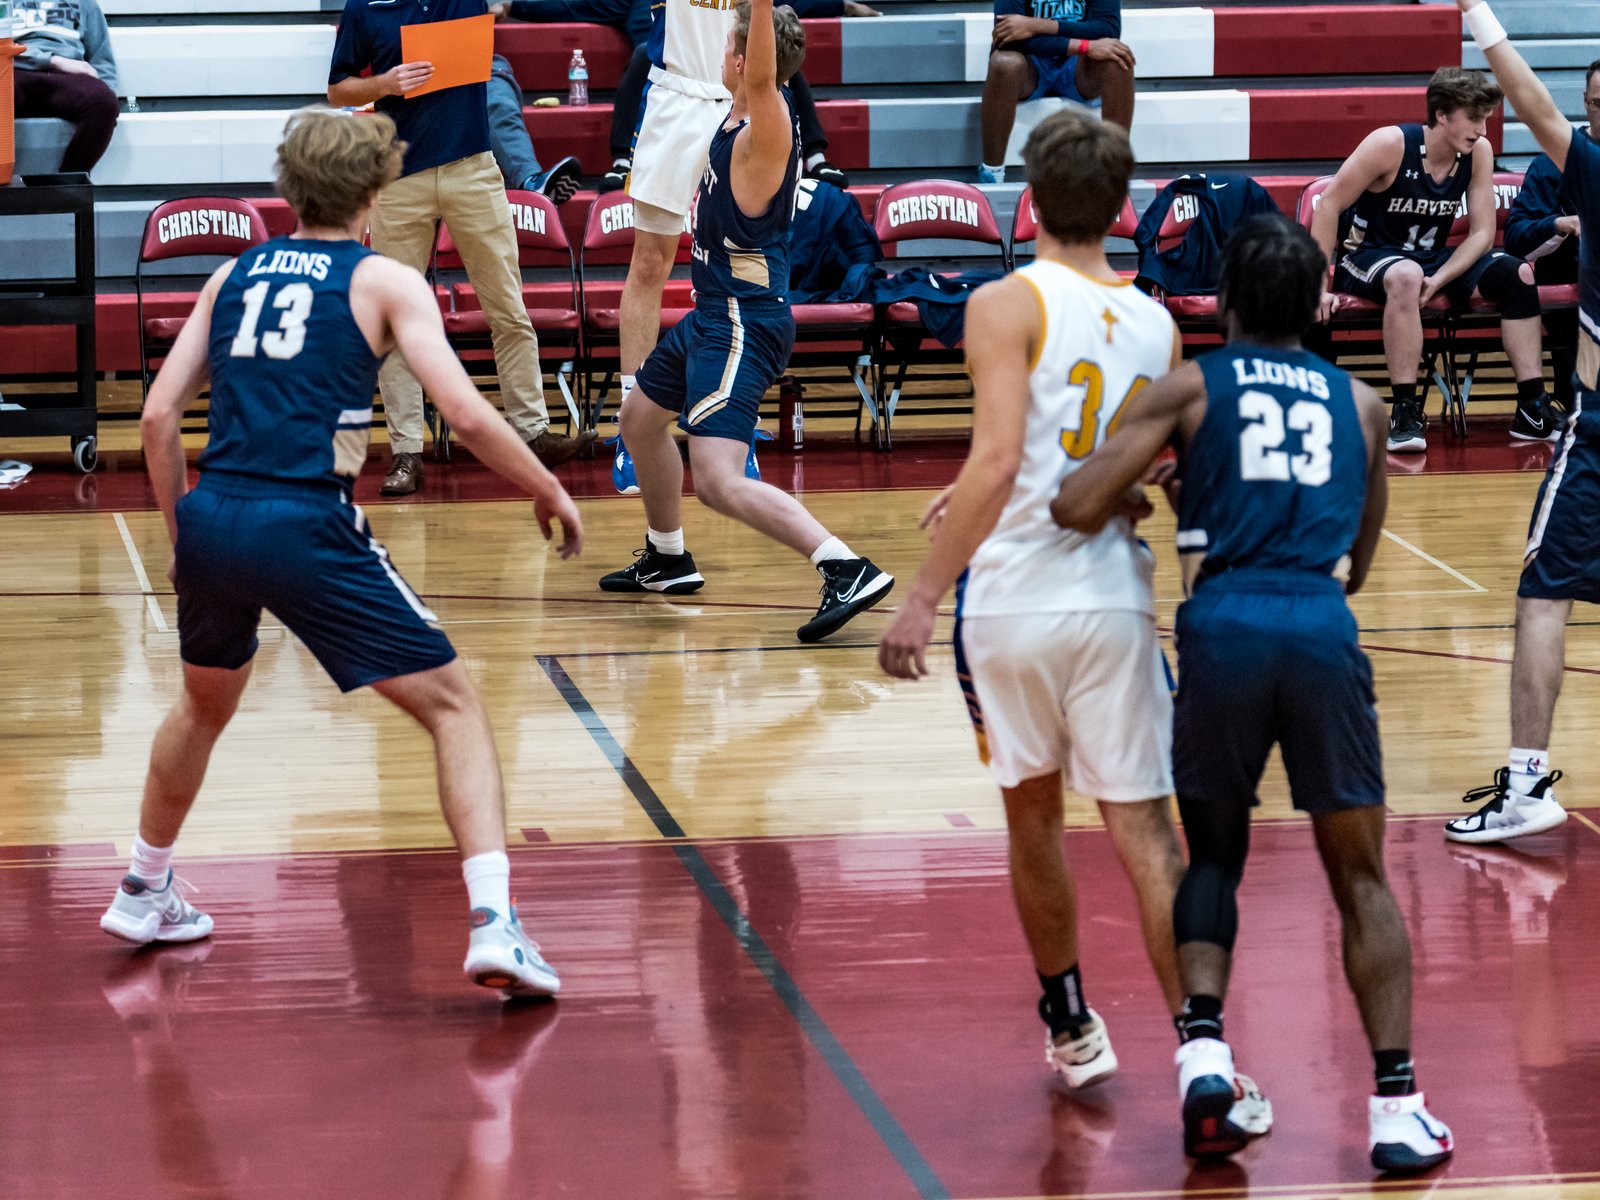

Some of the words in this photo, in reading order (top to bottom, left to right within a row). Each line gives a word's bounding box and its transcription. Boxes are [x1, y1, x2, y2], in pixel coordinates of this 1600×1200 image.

[13, 8, 80, 30] 2024
[158, 208, 251, 244] CHRISTIAN
[888, 194, 978, 228] CHRISTIAN
[1402, 224, 1439, 251] 14
[247, 249, 332, 282] LIONS
[230, 280, 314, 360] 13
[1231, 357, 1330, 401] LIONS
[1237, 389, 1334, 487] 23
